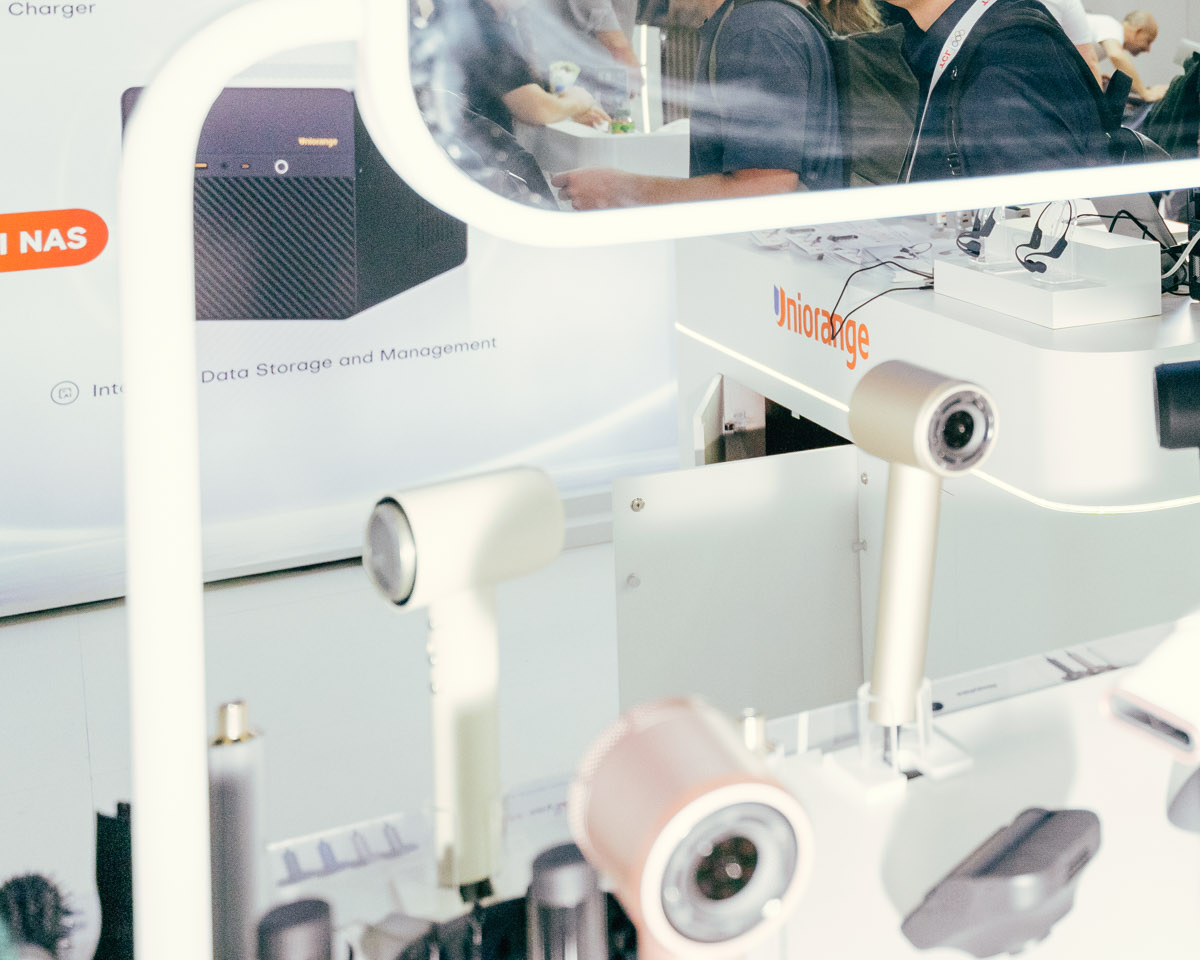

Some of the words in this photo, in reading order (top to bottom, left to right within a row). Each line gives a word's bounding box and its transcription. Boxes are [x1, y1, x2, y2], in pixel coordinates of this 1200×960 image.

[8, 2, 96, 19] Charger
[20, 226, 87, 254] NAS
[773, 283, 870, 370] Uniorange
[201, 365, 249, 383] Data
[256, 355, 333, 376] Storage
[339, 349, 374, 367] and
[380, 337, 497, 362] Management
